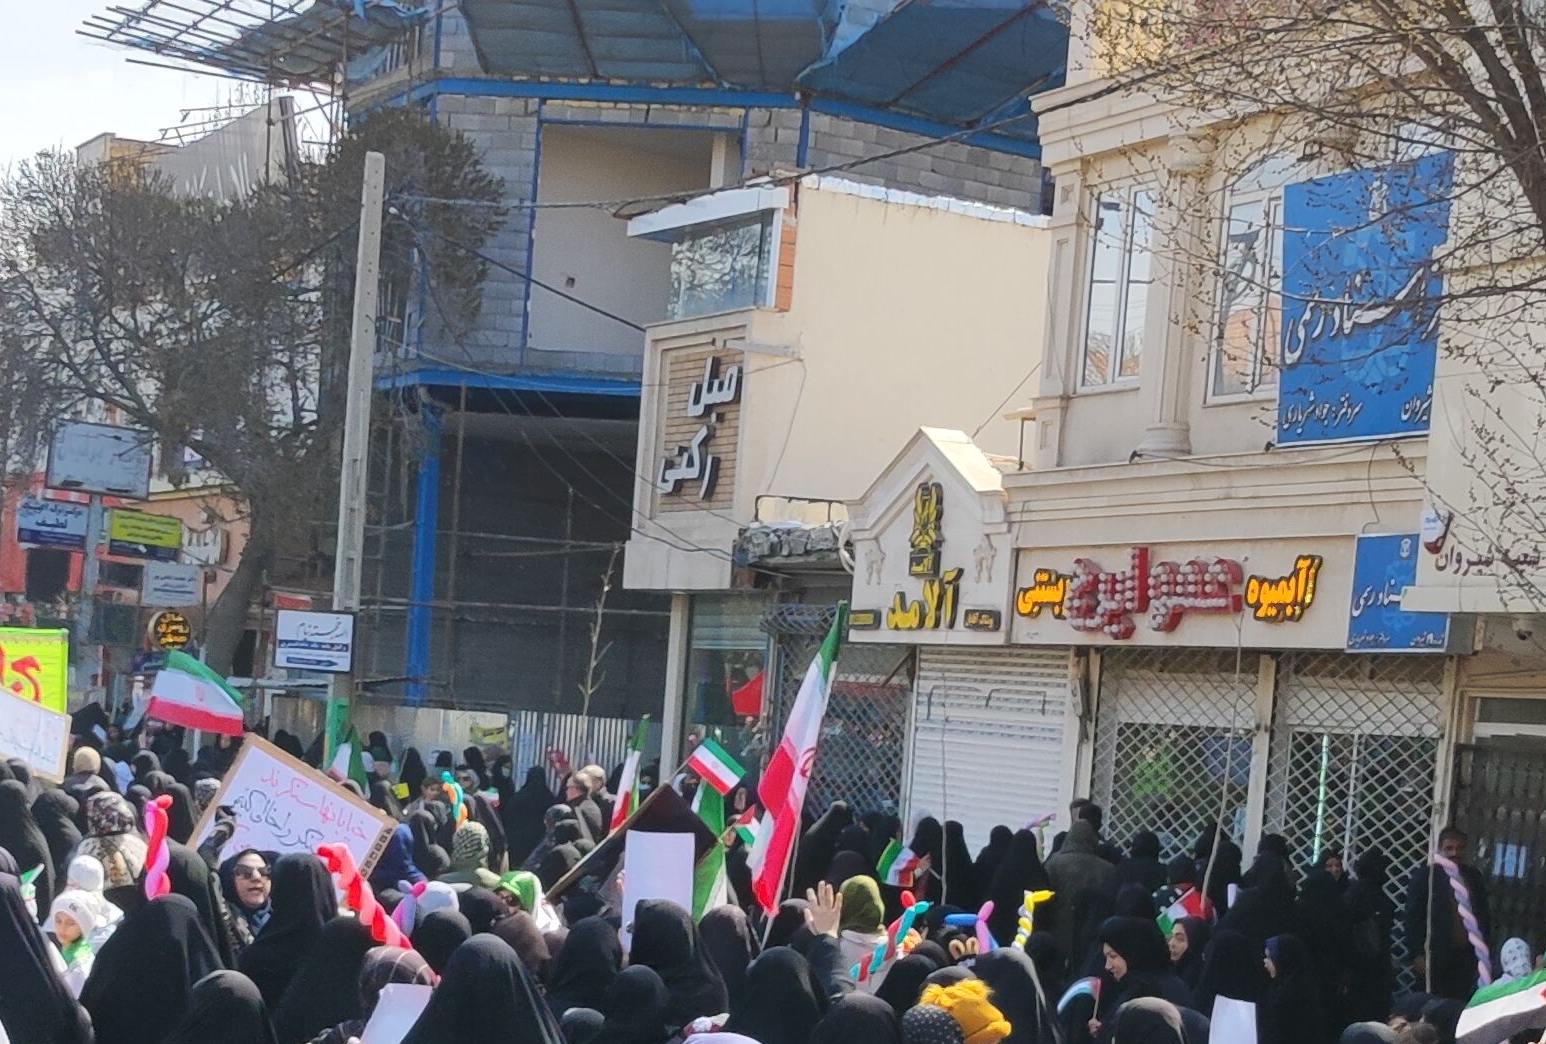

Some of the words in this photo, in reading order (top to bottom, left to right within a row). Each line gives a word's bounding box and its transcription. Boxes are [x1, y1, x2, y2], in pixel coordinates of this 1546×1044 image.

[687, 356, 740, 424] مبل
[1244, 554, 1323, 622] آبمیوه
[1434, 543, 1496, 577] شیروان
[1016, 567, 1071, 619] بستنی
